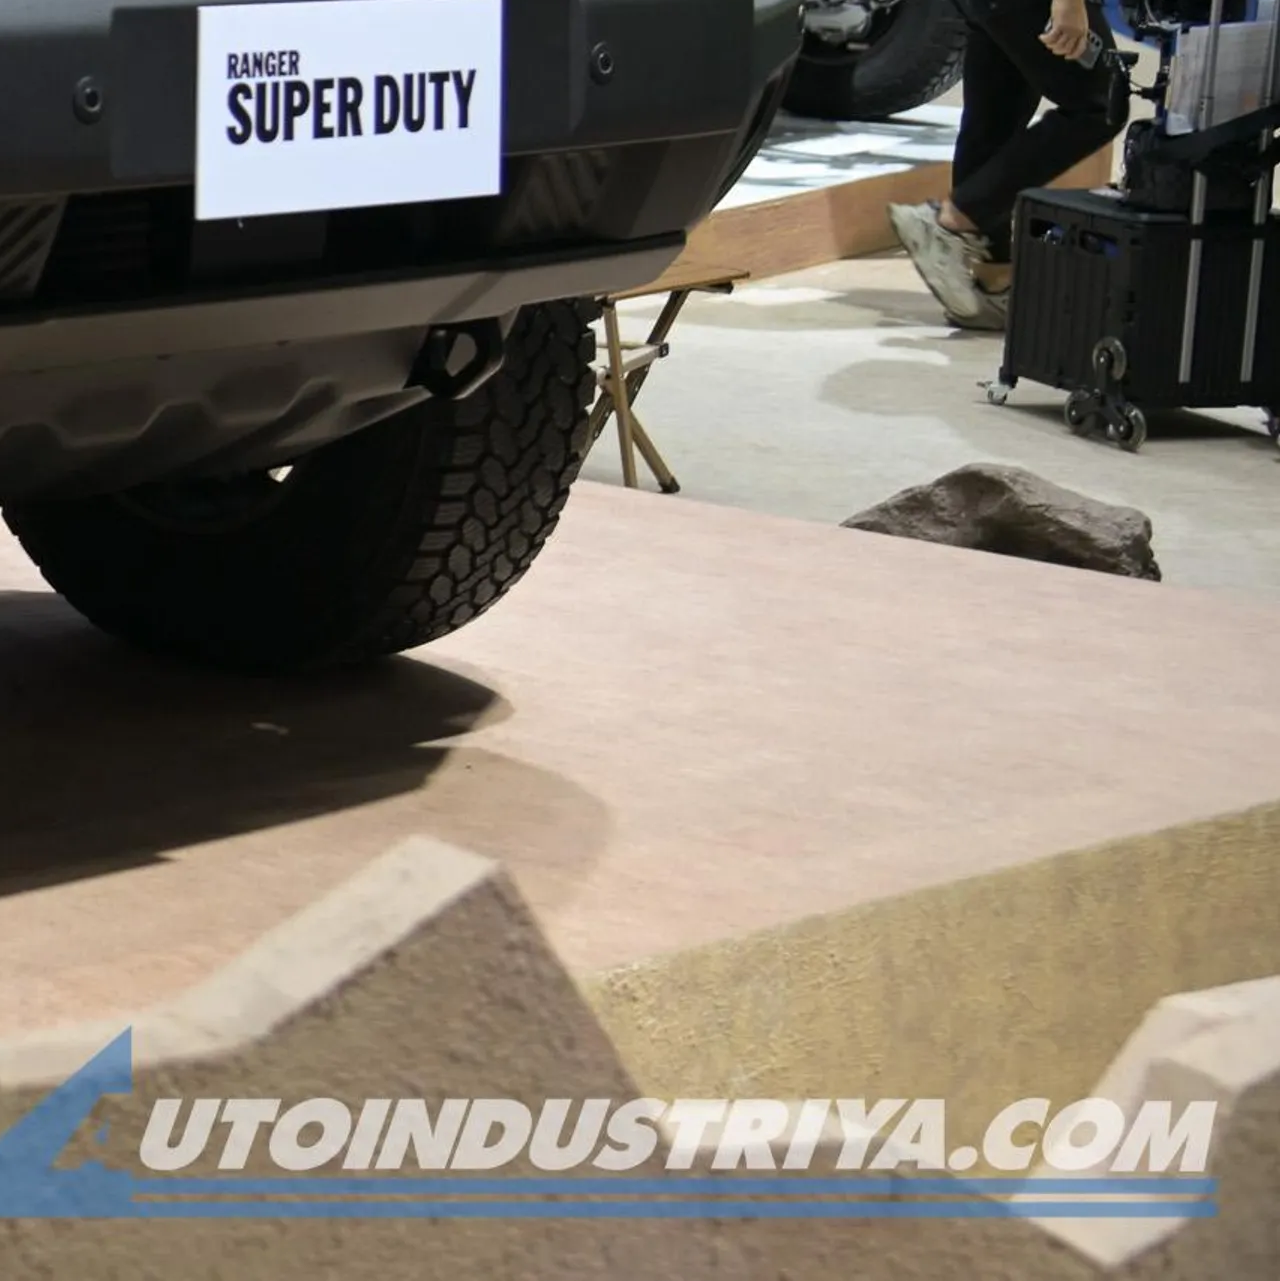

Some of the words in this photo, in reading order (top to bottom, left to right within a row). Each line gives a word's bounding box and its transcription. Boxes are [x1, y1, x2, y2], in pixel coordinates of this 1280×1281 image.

[226, 50, 300, 79] RANGER
[226, 76, 364, 145] SUPER
[374, 69, 477, 135] DUTY
